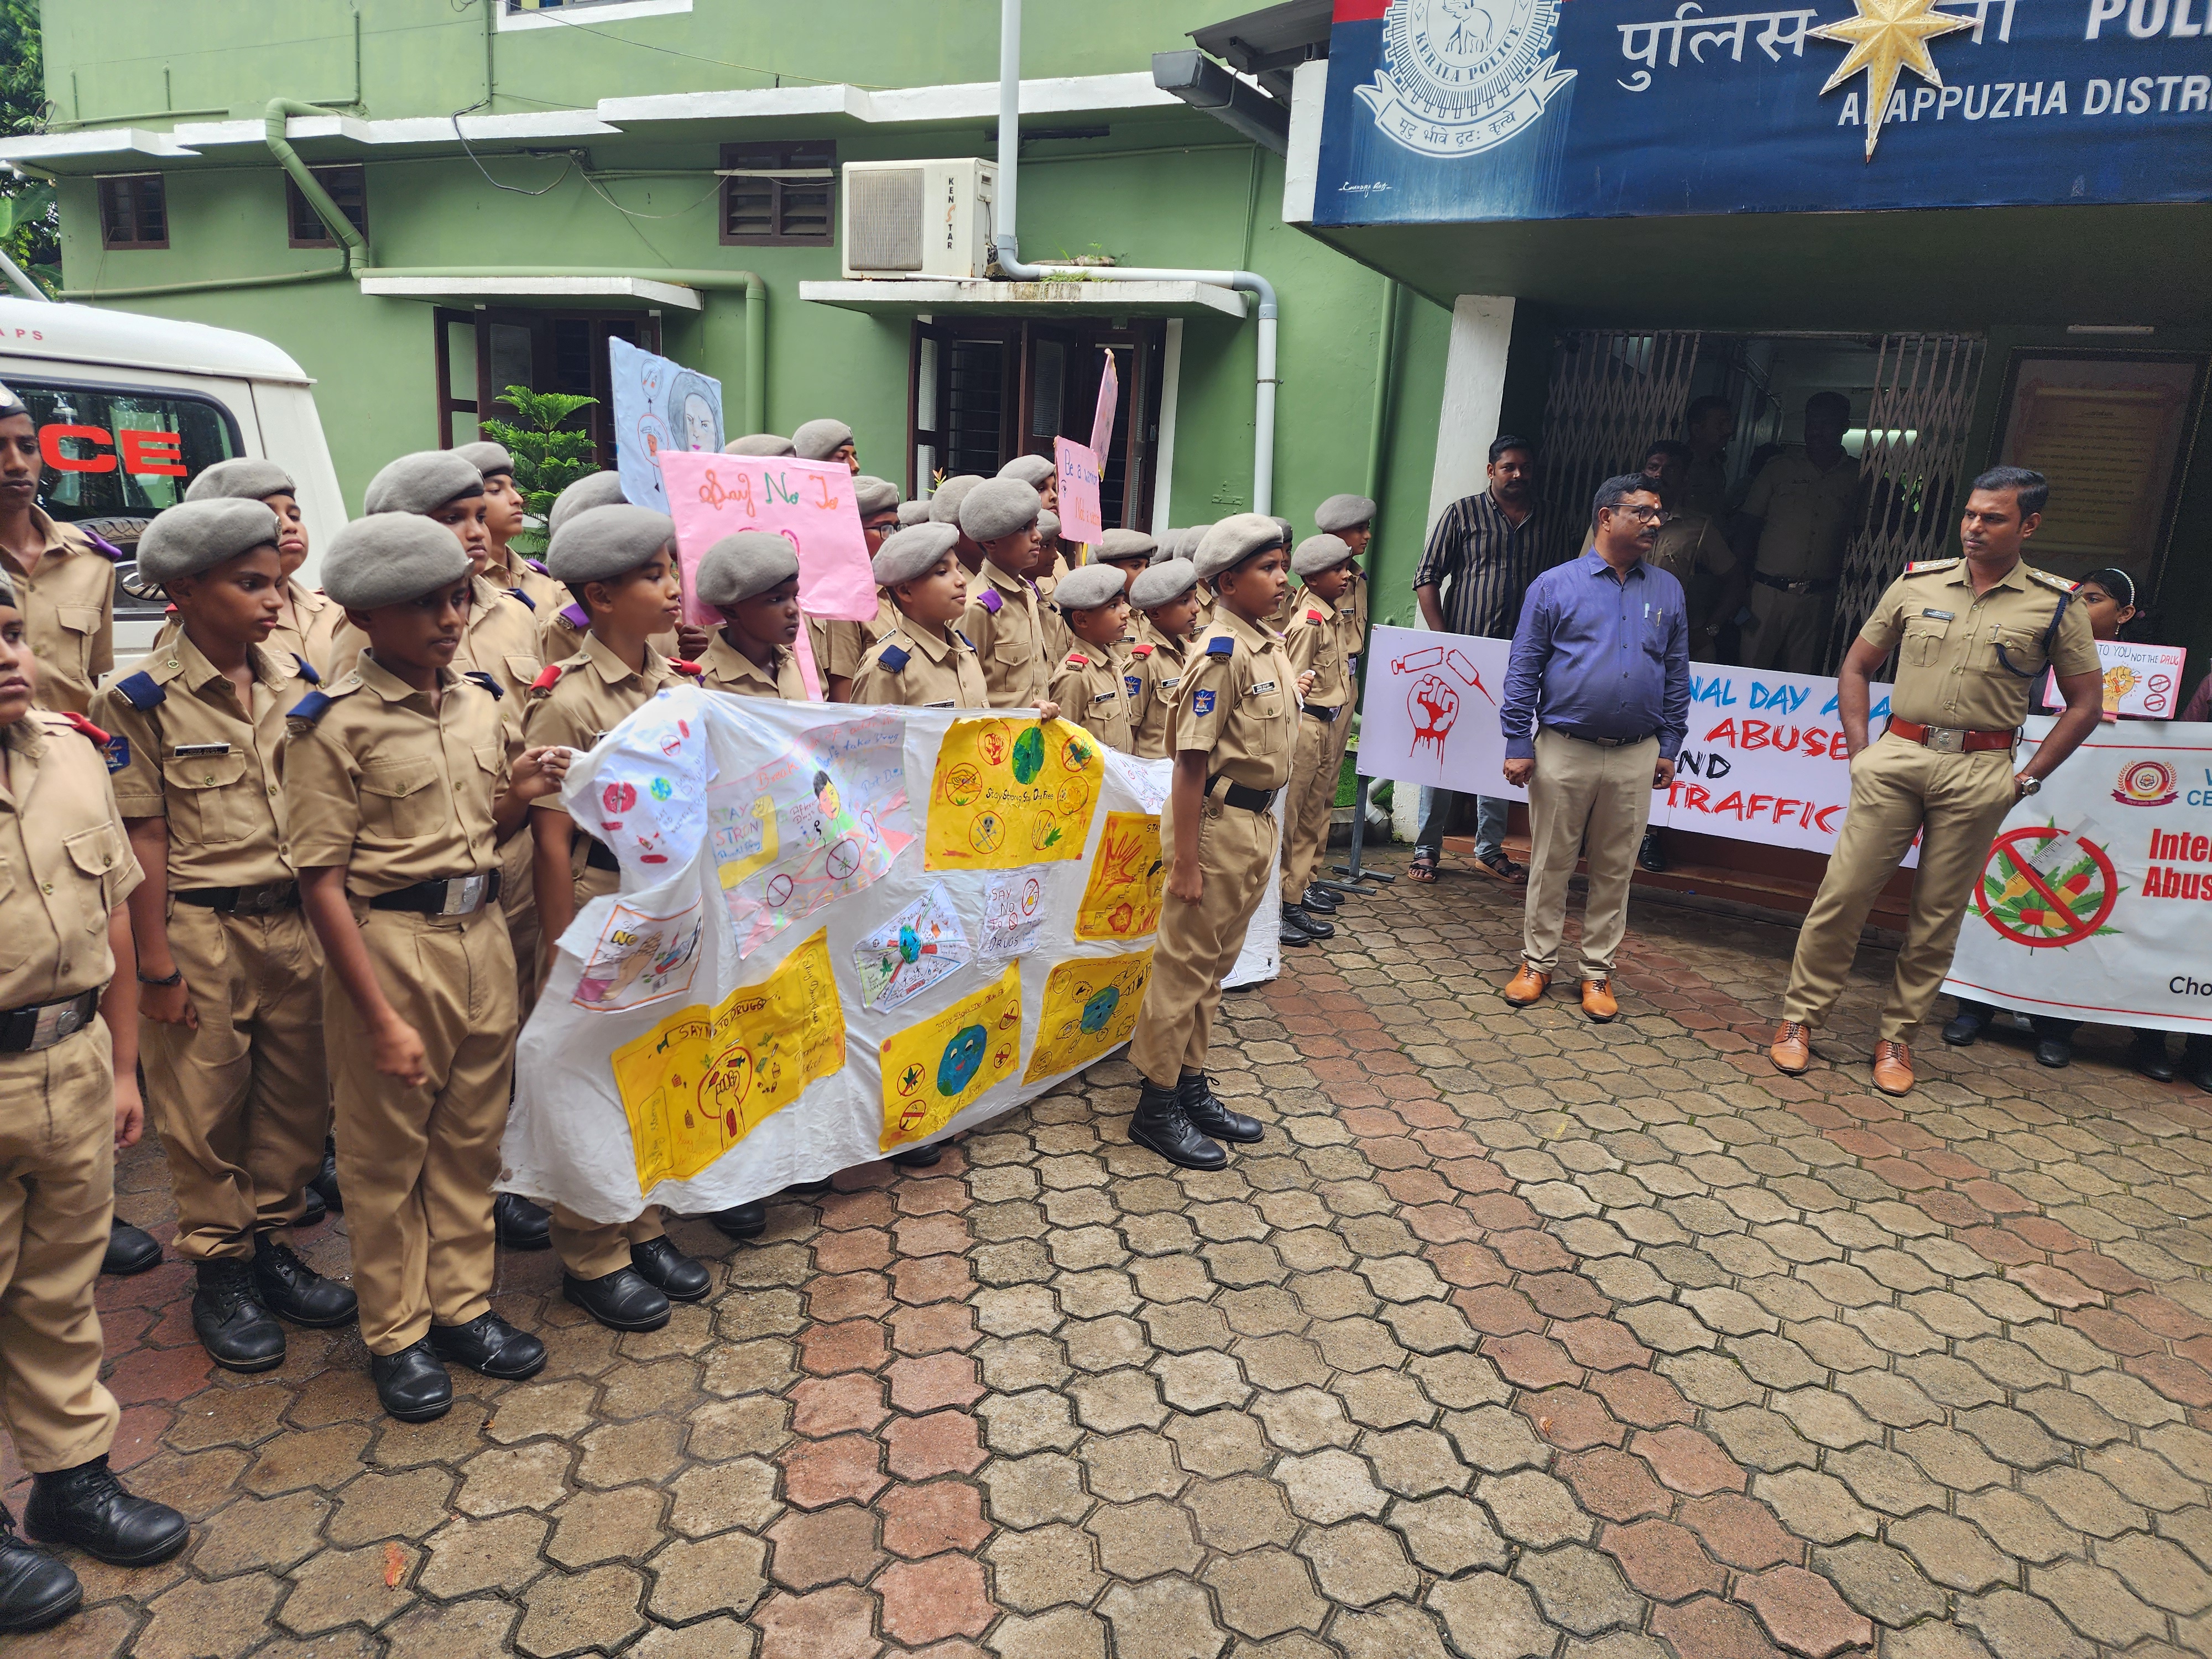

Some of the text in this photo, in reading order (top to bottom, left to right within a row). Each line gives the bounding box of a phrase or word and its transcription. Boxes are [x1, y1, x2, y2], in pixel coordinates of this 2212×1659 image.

[1416, 24, 1522, 82] KERALA POLICE
[1617, 2, 1818, 92] पुलिस
[1065, 448, 1073, 476] Be
[1077, 464, 1082, 479] a
[765, 472, 799, 505] No
[2099, 644, 2179, 666] TO YOU NOT THE DRUG
[1749, 681, 1812, 716] DAY
[843, 739, 871, 751] take
[1703, 717, 1850, 761] ABUSE
[986, 787, 1002, 804] Stay
[1043, 790, 1053, 800] Free
[711, 803, 748, 825] STAY
[2149, 828, 2212, 863] Inte
[992, 888, 1011, 901] SAY
[1001, 902, 1015, 915] NO
[611, 930, 637, 946] NO
[989, 936, 1019, 951] DRUGS
[2169, 976, 2212, 997] Cho
[679, 1026, 702, 1040] SAY
[719, 1018, 729, 1029] TO
